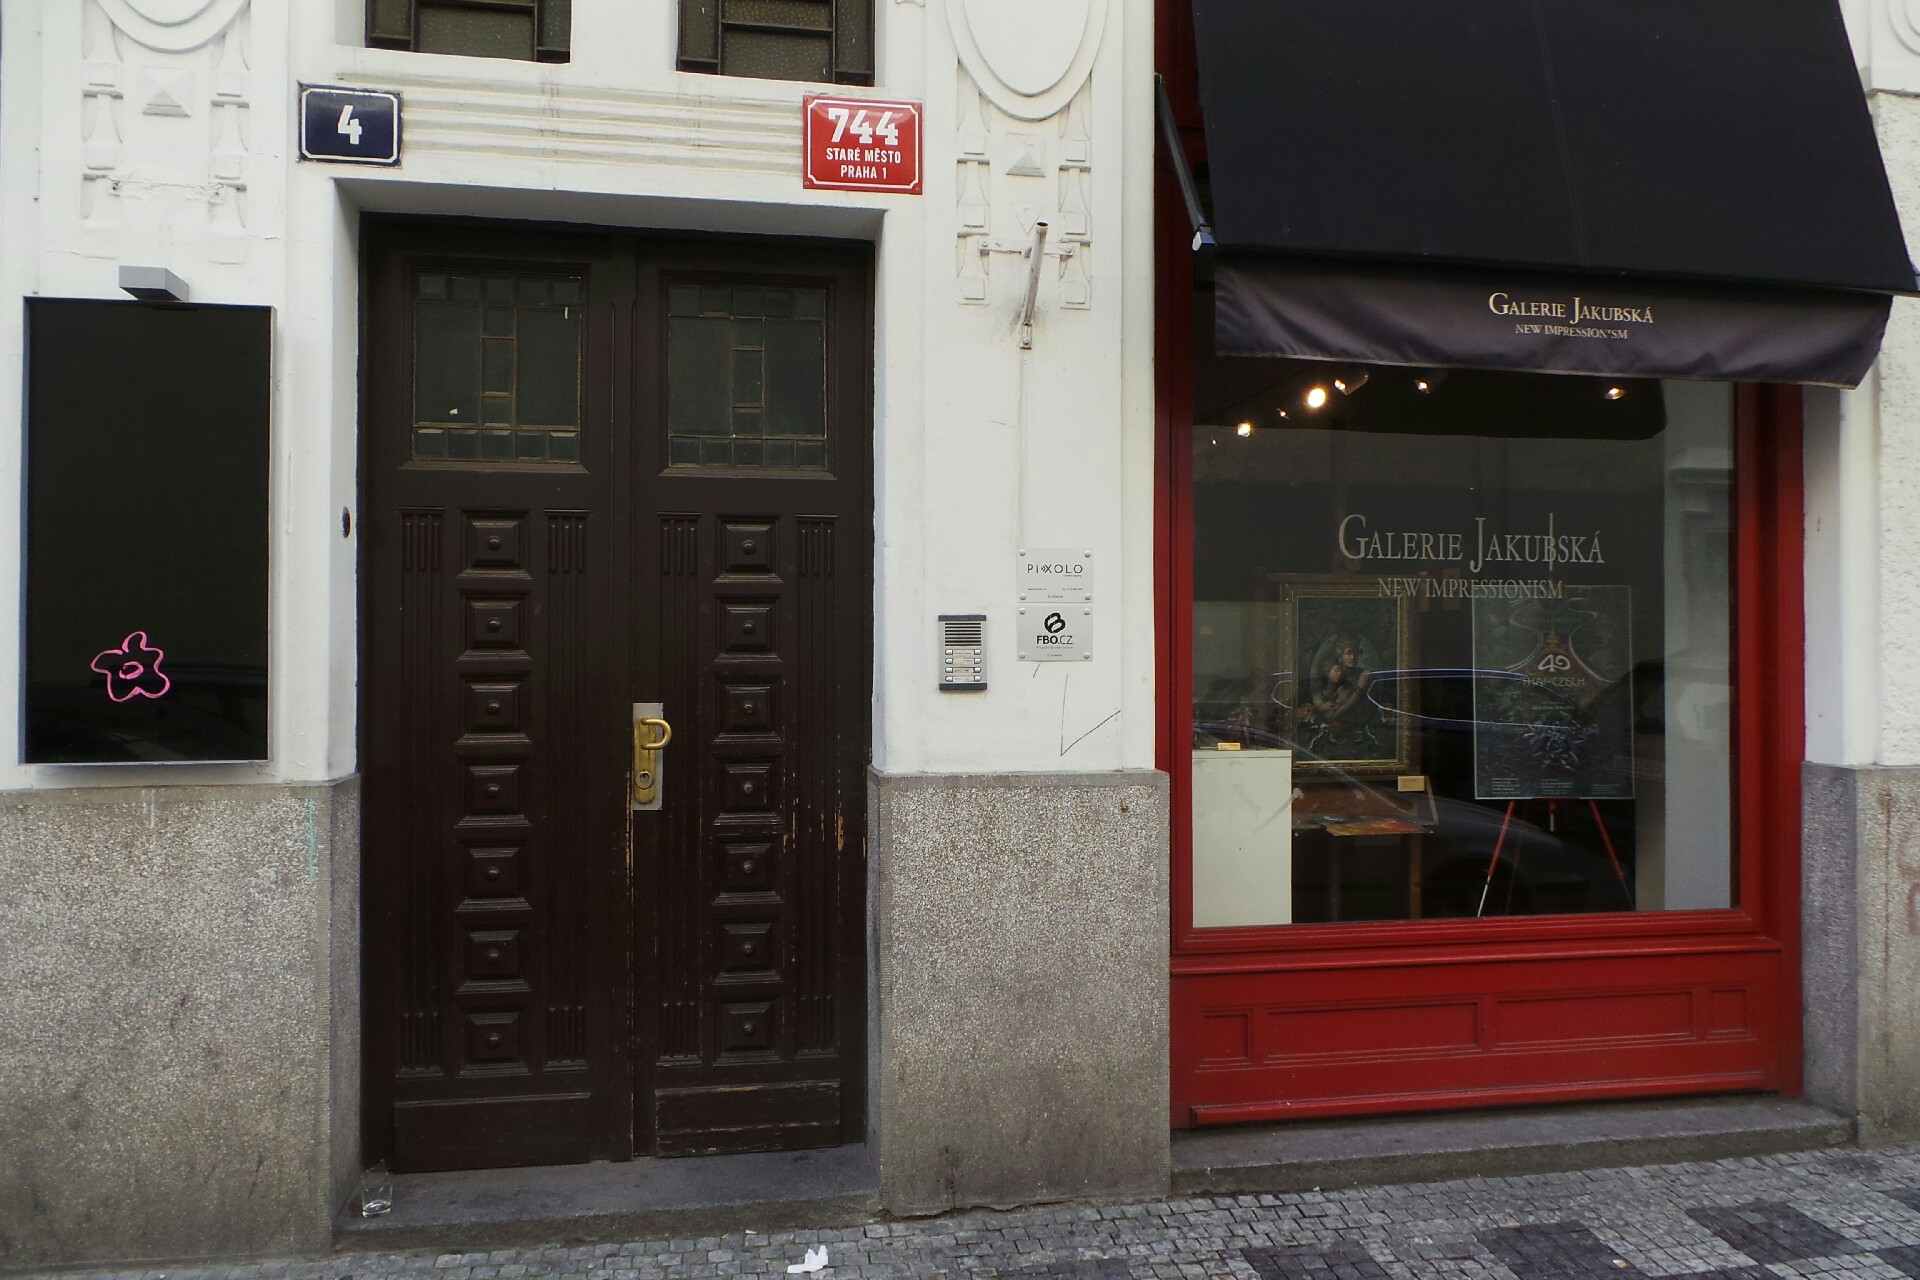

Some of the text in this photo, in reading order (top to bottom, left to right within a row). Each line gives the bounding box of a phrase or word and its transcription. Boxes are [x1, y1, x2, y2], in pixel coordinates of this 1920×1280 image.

[338, 104, 362, 144] 4
[828, 108, 899, 145] 744
[826, 147, 901, 163] STARÉ MĚSTO
[841, 165, 887, 179] PRAHA 1
[1514, 323, 1542, 335] NEW
[1377, 577, 1564, 600] NEW IMPRESSIONISM
[1036, 635, 1073, 645] FBO.CZ
